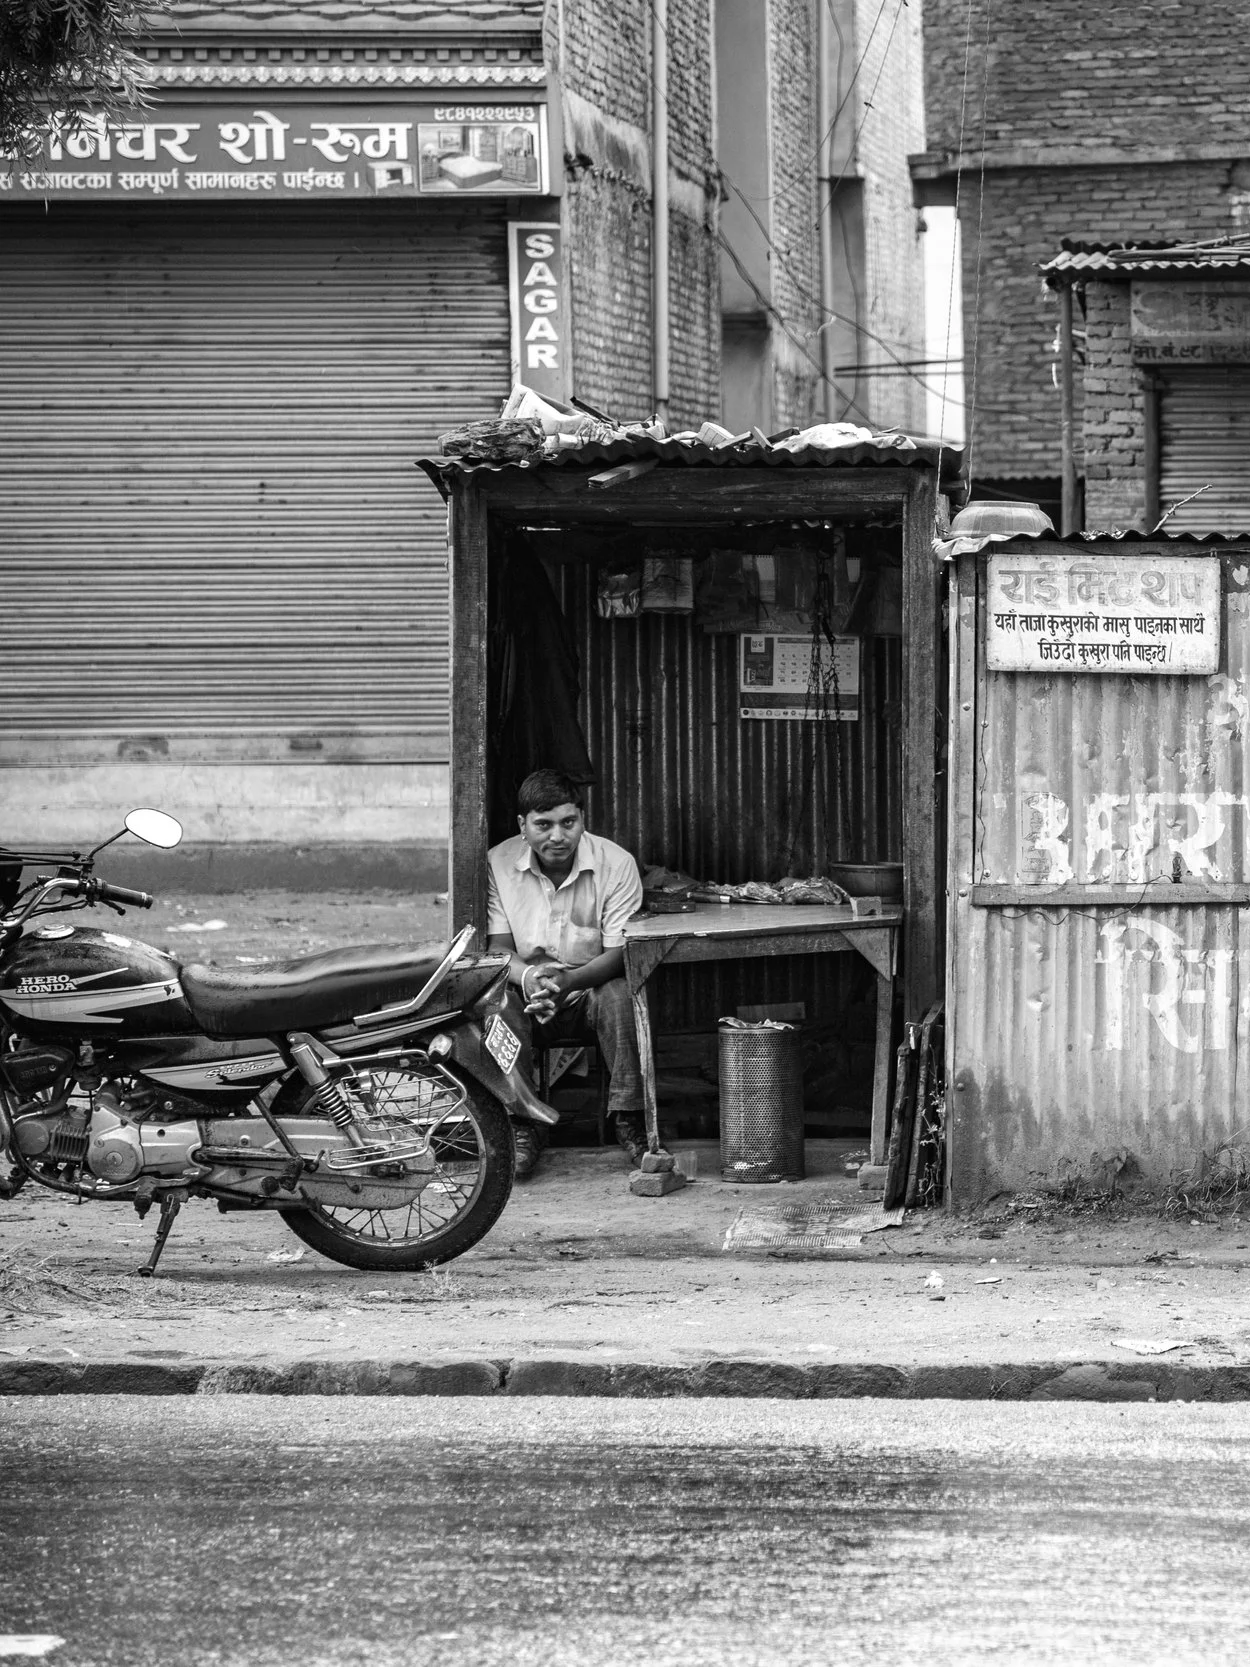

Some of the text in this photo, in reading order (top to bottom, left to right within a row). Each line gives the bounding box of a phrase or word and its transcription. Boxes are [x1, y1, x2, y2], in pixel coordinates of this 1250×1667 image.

[118, 168, 180, 194] सम्पूर्ण
[523, 233, 559, 369] SAGAR
[998, 562, 1062, 609] राई
[994, 609, 1017, 634] यहाँ
[1019, 614, 1047, 633] ताजा
[1047, 611, 1100, 638] कुखुराको
[1102, 616, 1131, 638] मासु
[1077, 643, 1110, 666] कुखुरा
[1111, 640, 1132, 662] पनि
[16, 982, 78, 994] HONDA
[20, 974, 71, 985] HERO
